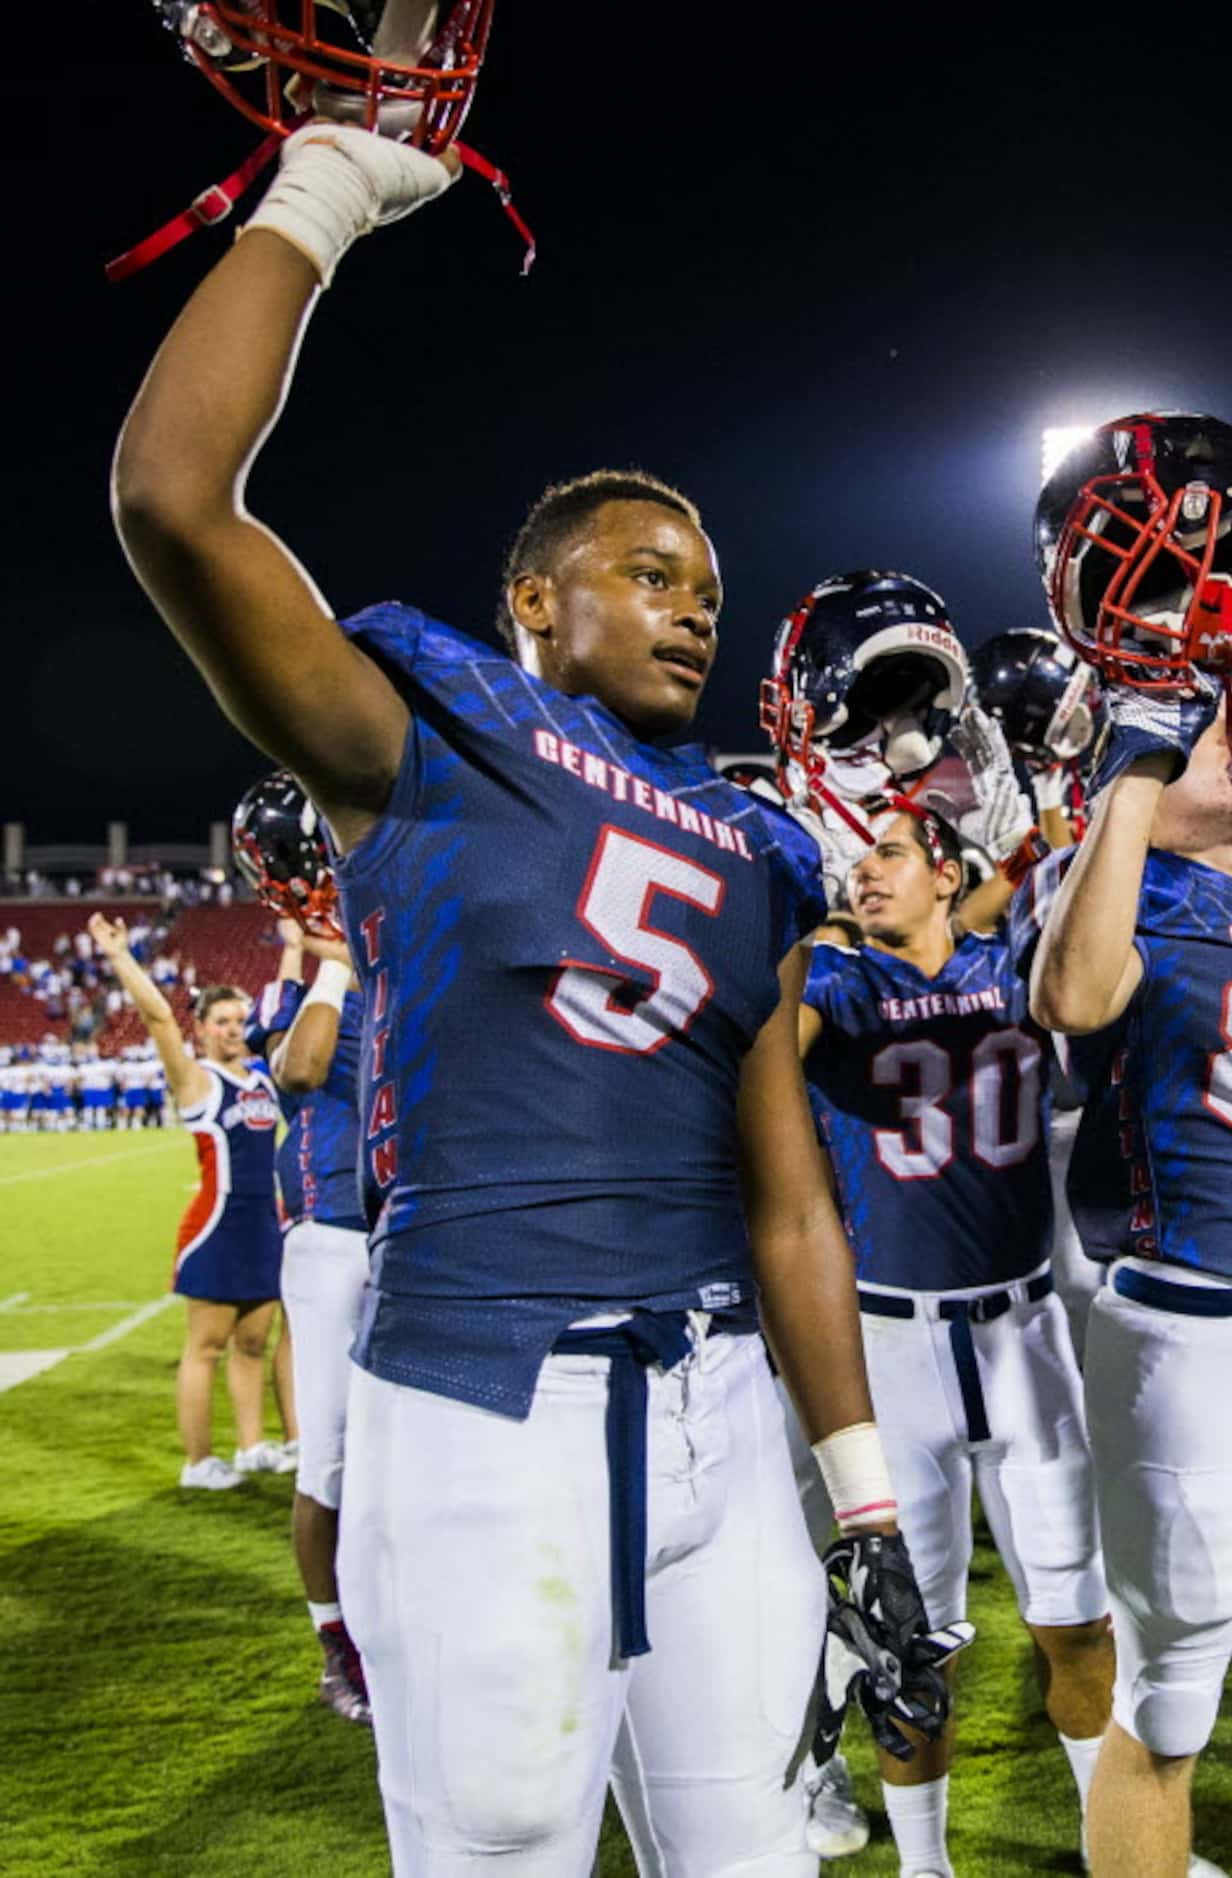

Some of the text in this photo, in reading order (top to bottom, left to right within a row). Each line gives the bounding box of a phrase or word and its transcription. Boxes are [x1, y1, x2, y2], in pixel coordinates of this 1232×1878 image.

[534, 728, 755, 861] CENTENNIAL
[543, 823, 727, 1055] 5
[871, 1024, 1043, 1183] 30
